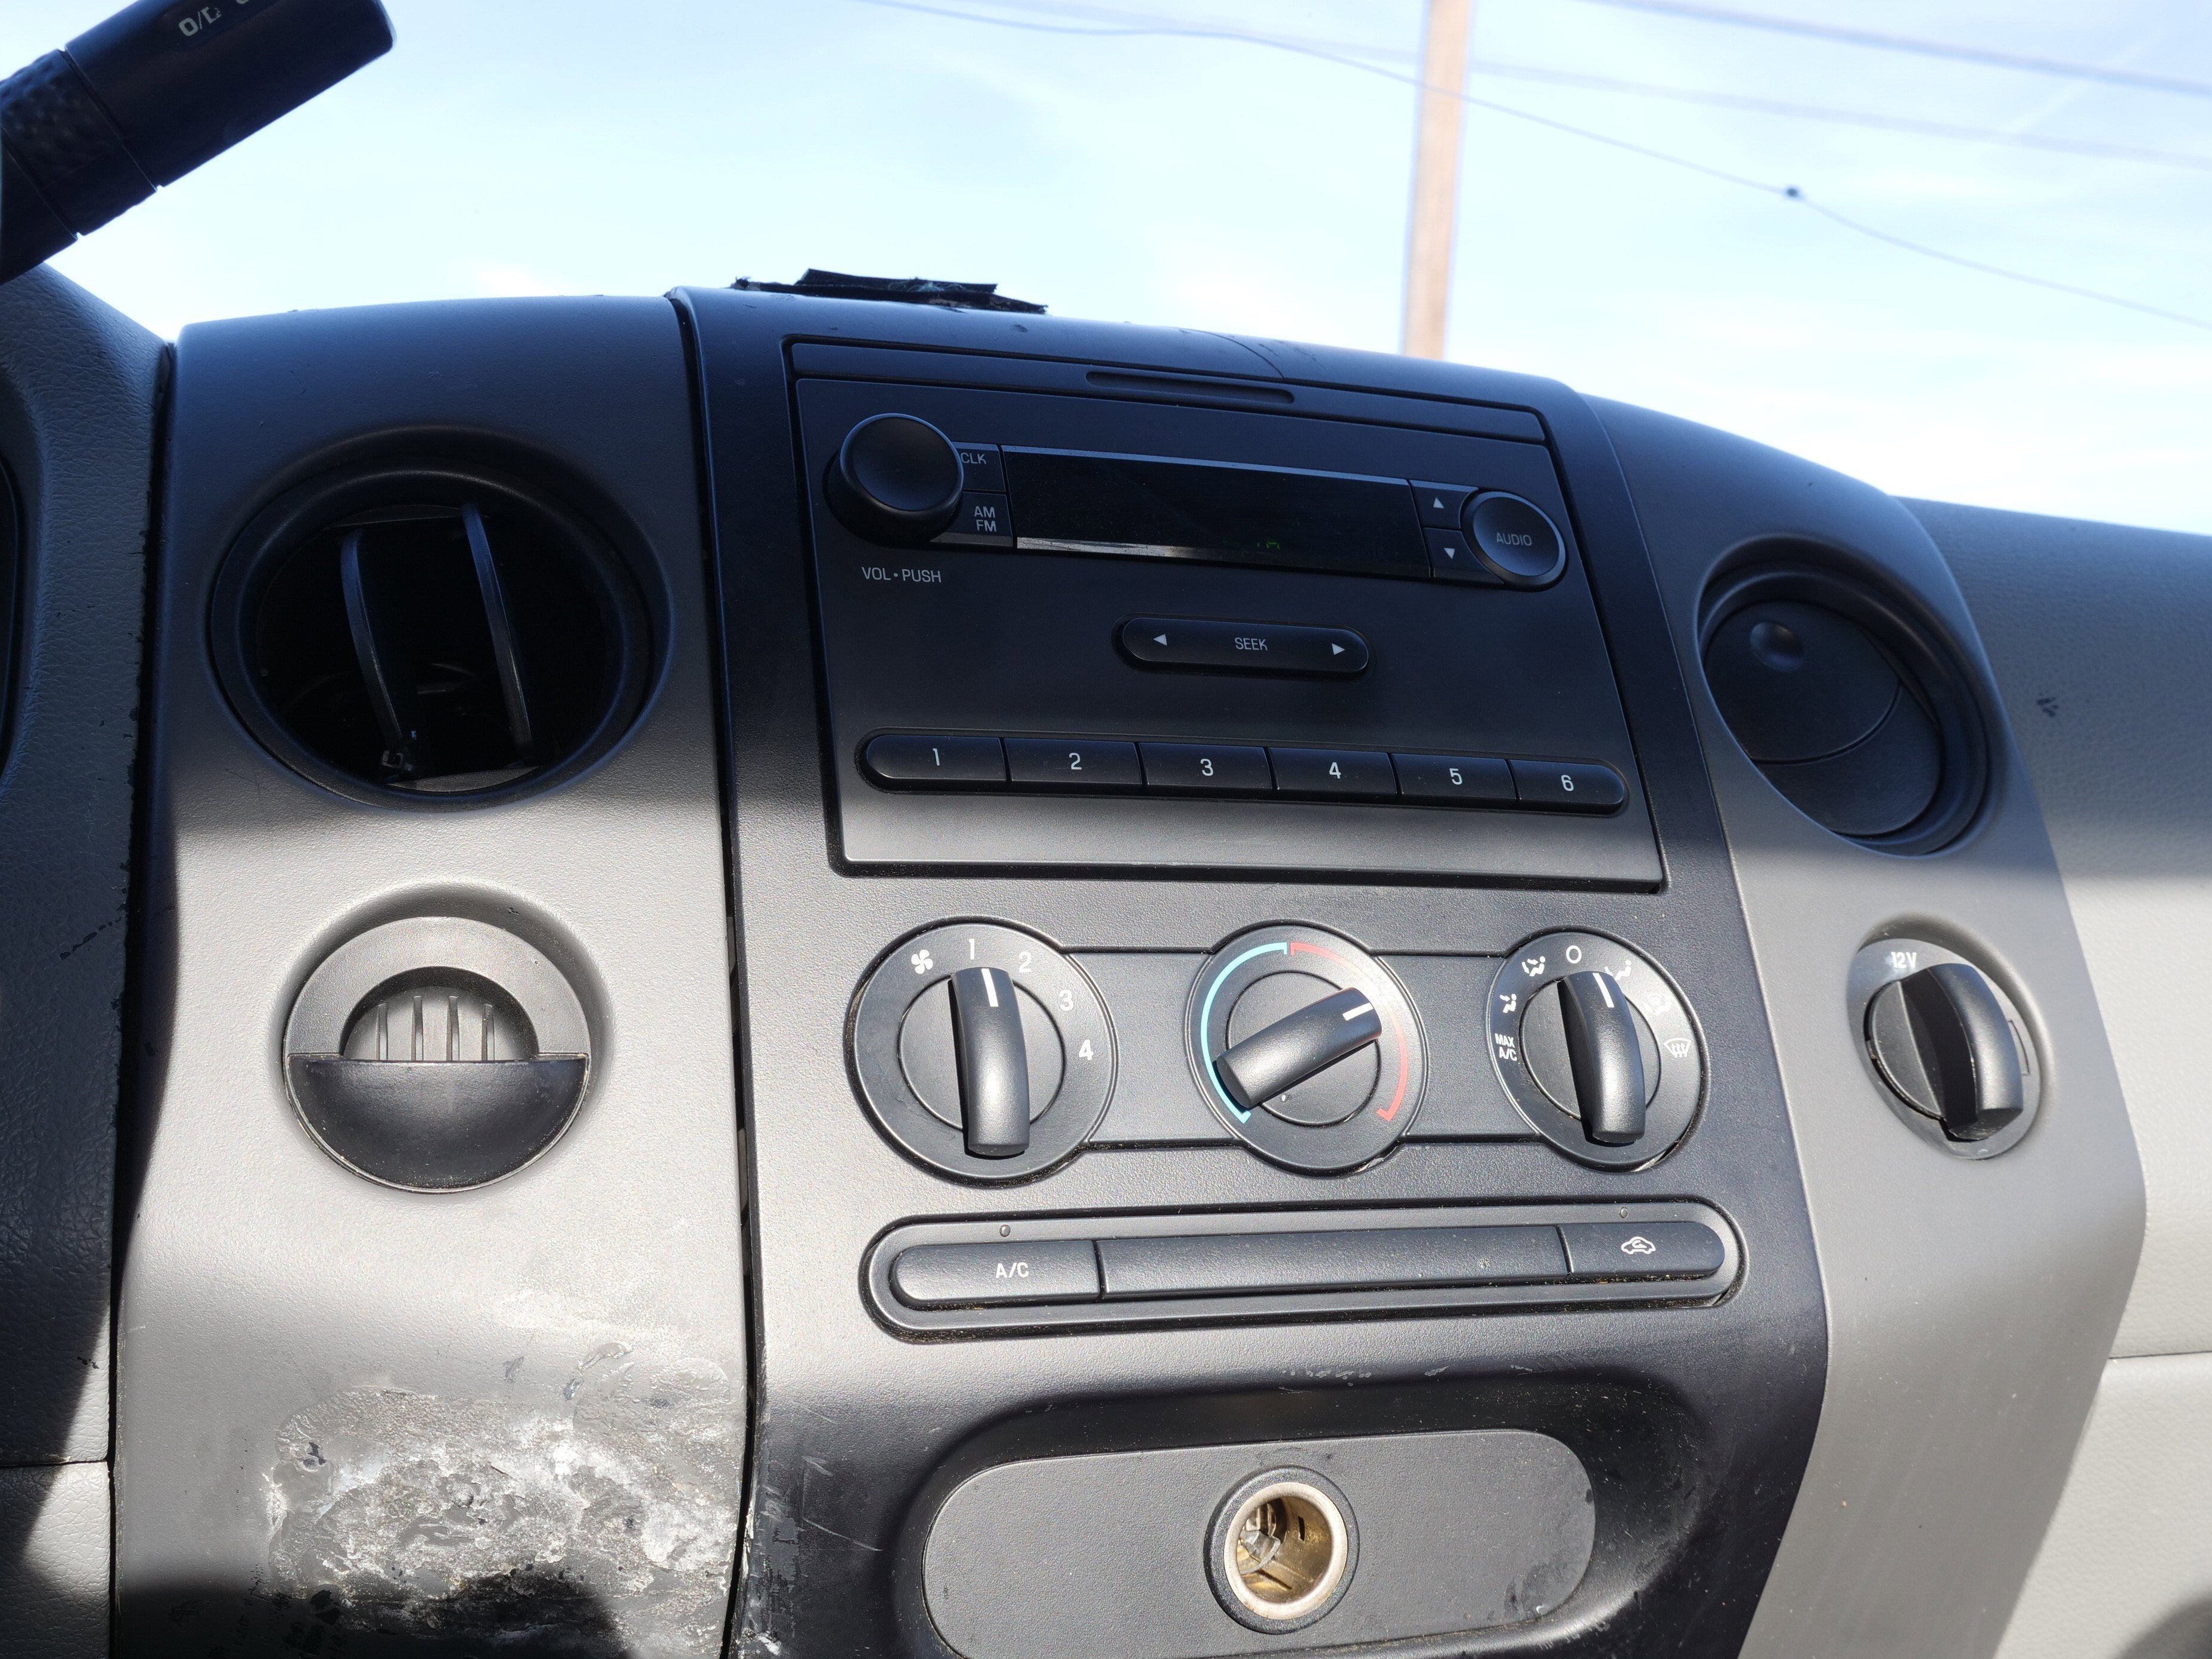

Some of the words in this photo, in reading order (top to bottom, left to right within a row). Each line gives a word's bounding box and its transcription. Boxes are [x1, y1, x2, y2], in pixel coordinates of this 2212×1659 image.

[960, 452, 987, 465] CLK
[974, 505, 996, 518] AM
[976, 519, 996, 532] FM
[1496, 532, 1532, 546] AUDIO
[902, 568, 942, 583] PUSH
[1234, 637, 1268, 651] SEEK
[933, 748, 940, 766] 1
[1069, 753, 1082, 770] 2
[1200, 759, 1214, 776] 3
[1329, 762, 1341, 779] 4
[1449, 768, 1462, 785] 5
[1561, 774, 1574, 791] 6
[968, 938, 975, 960] 1
[1018, 950, 1032, 973] 2
[1890, 952, 1917, 968] 12V
[1058, 989, 1074, 1011] 3
[1495, 1033, 1515, 1048] MAX
[1079, 1039, 1094, 1061] 4
[1499, 1047, 1518, 1061] A/C
[995, 1262, 1030, 1279] A/C
